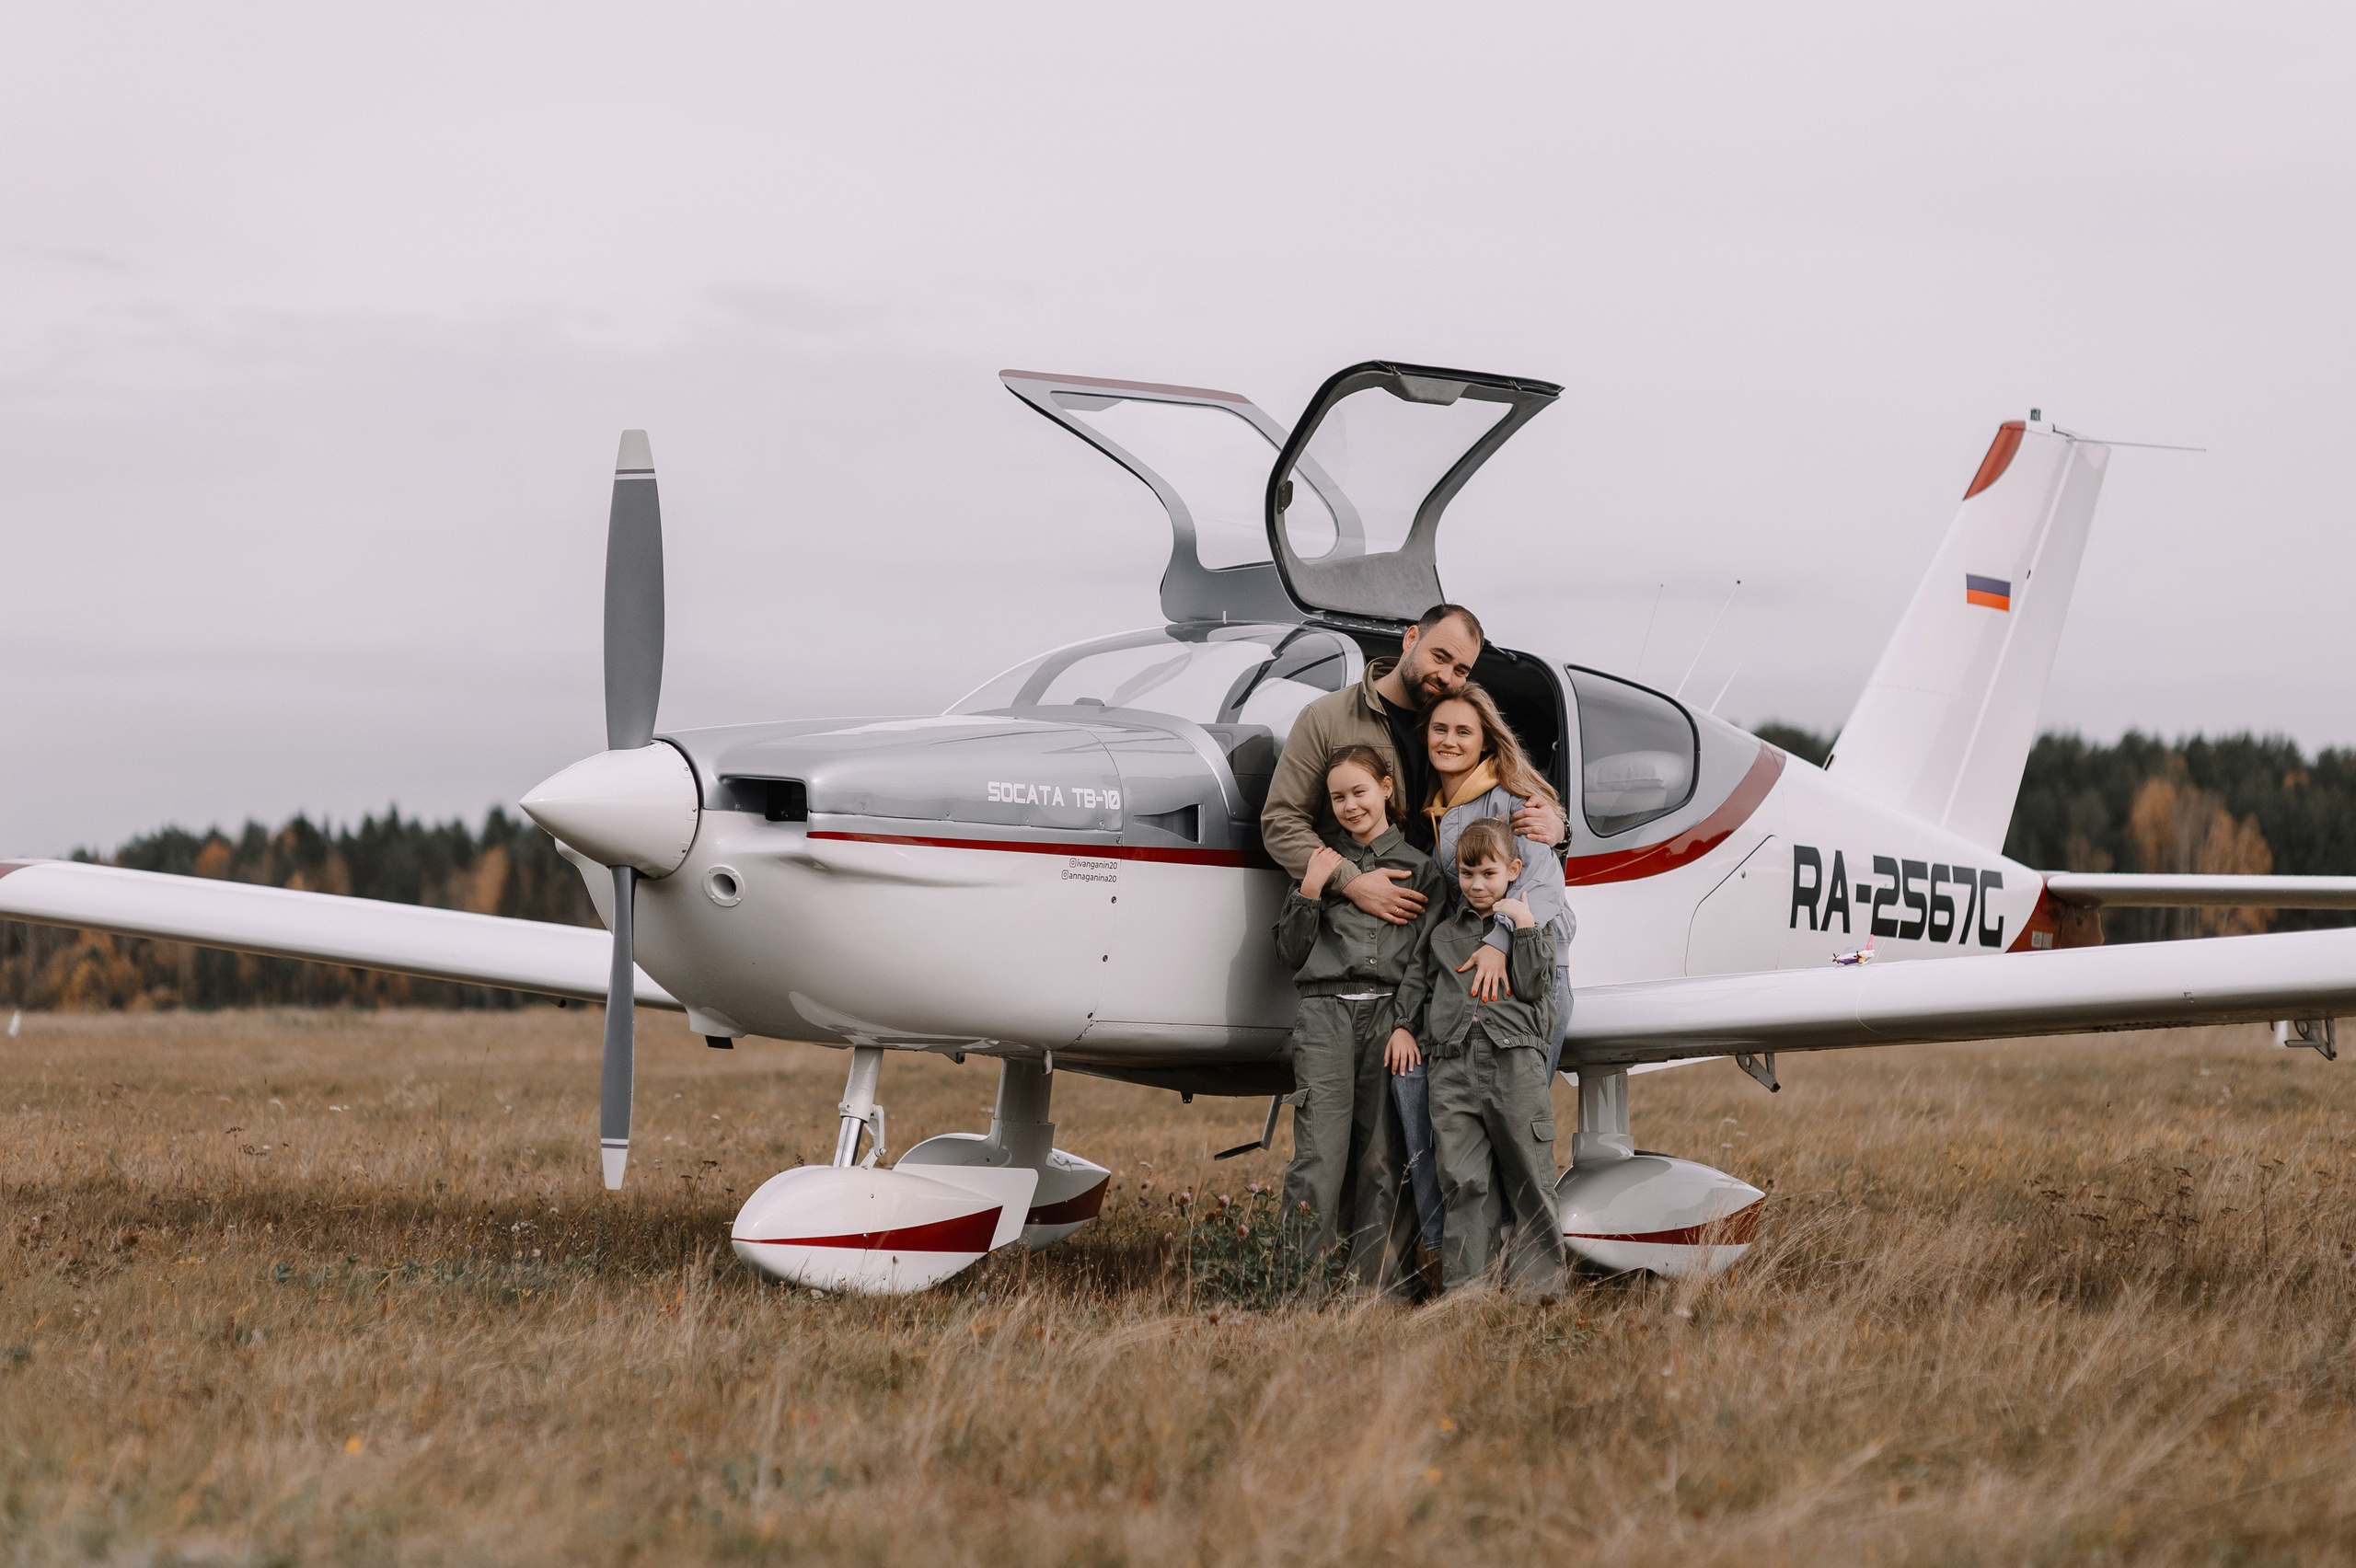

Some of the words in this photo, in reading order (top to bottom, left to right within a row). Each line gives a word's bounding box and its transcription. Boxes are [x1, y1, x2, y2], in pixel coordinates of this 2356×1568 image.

[987, 781, 1065, 807] SOCATA
[1071, 787, 1121, 810] TB-10
[1789, 844, 2004, 948] RA-2567G
